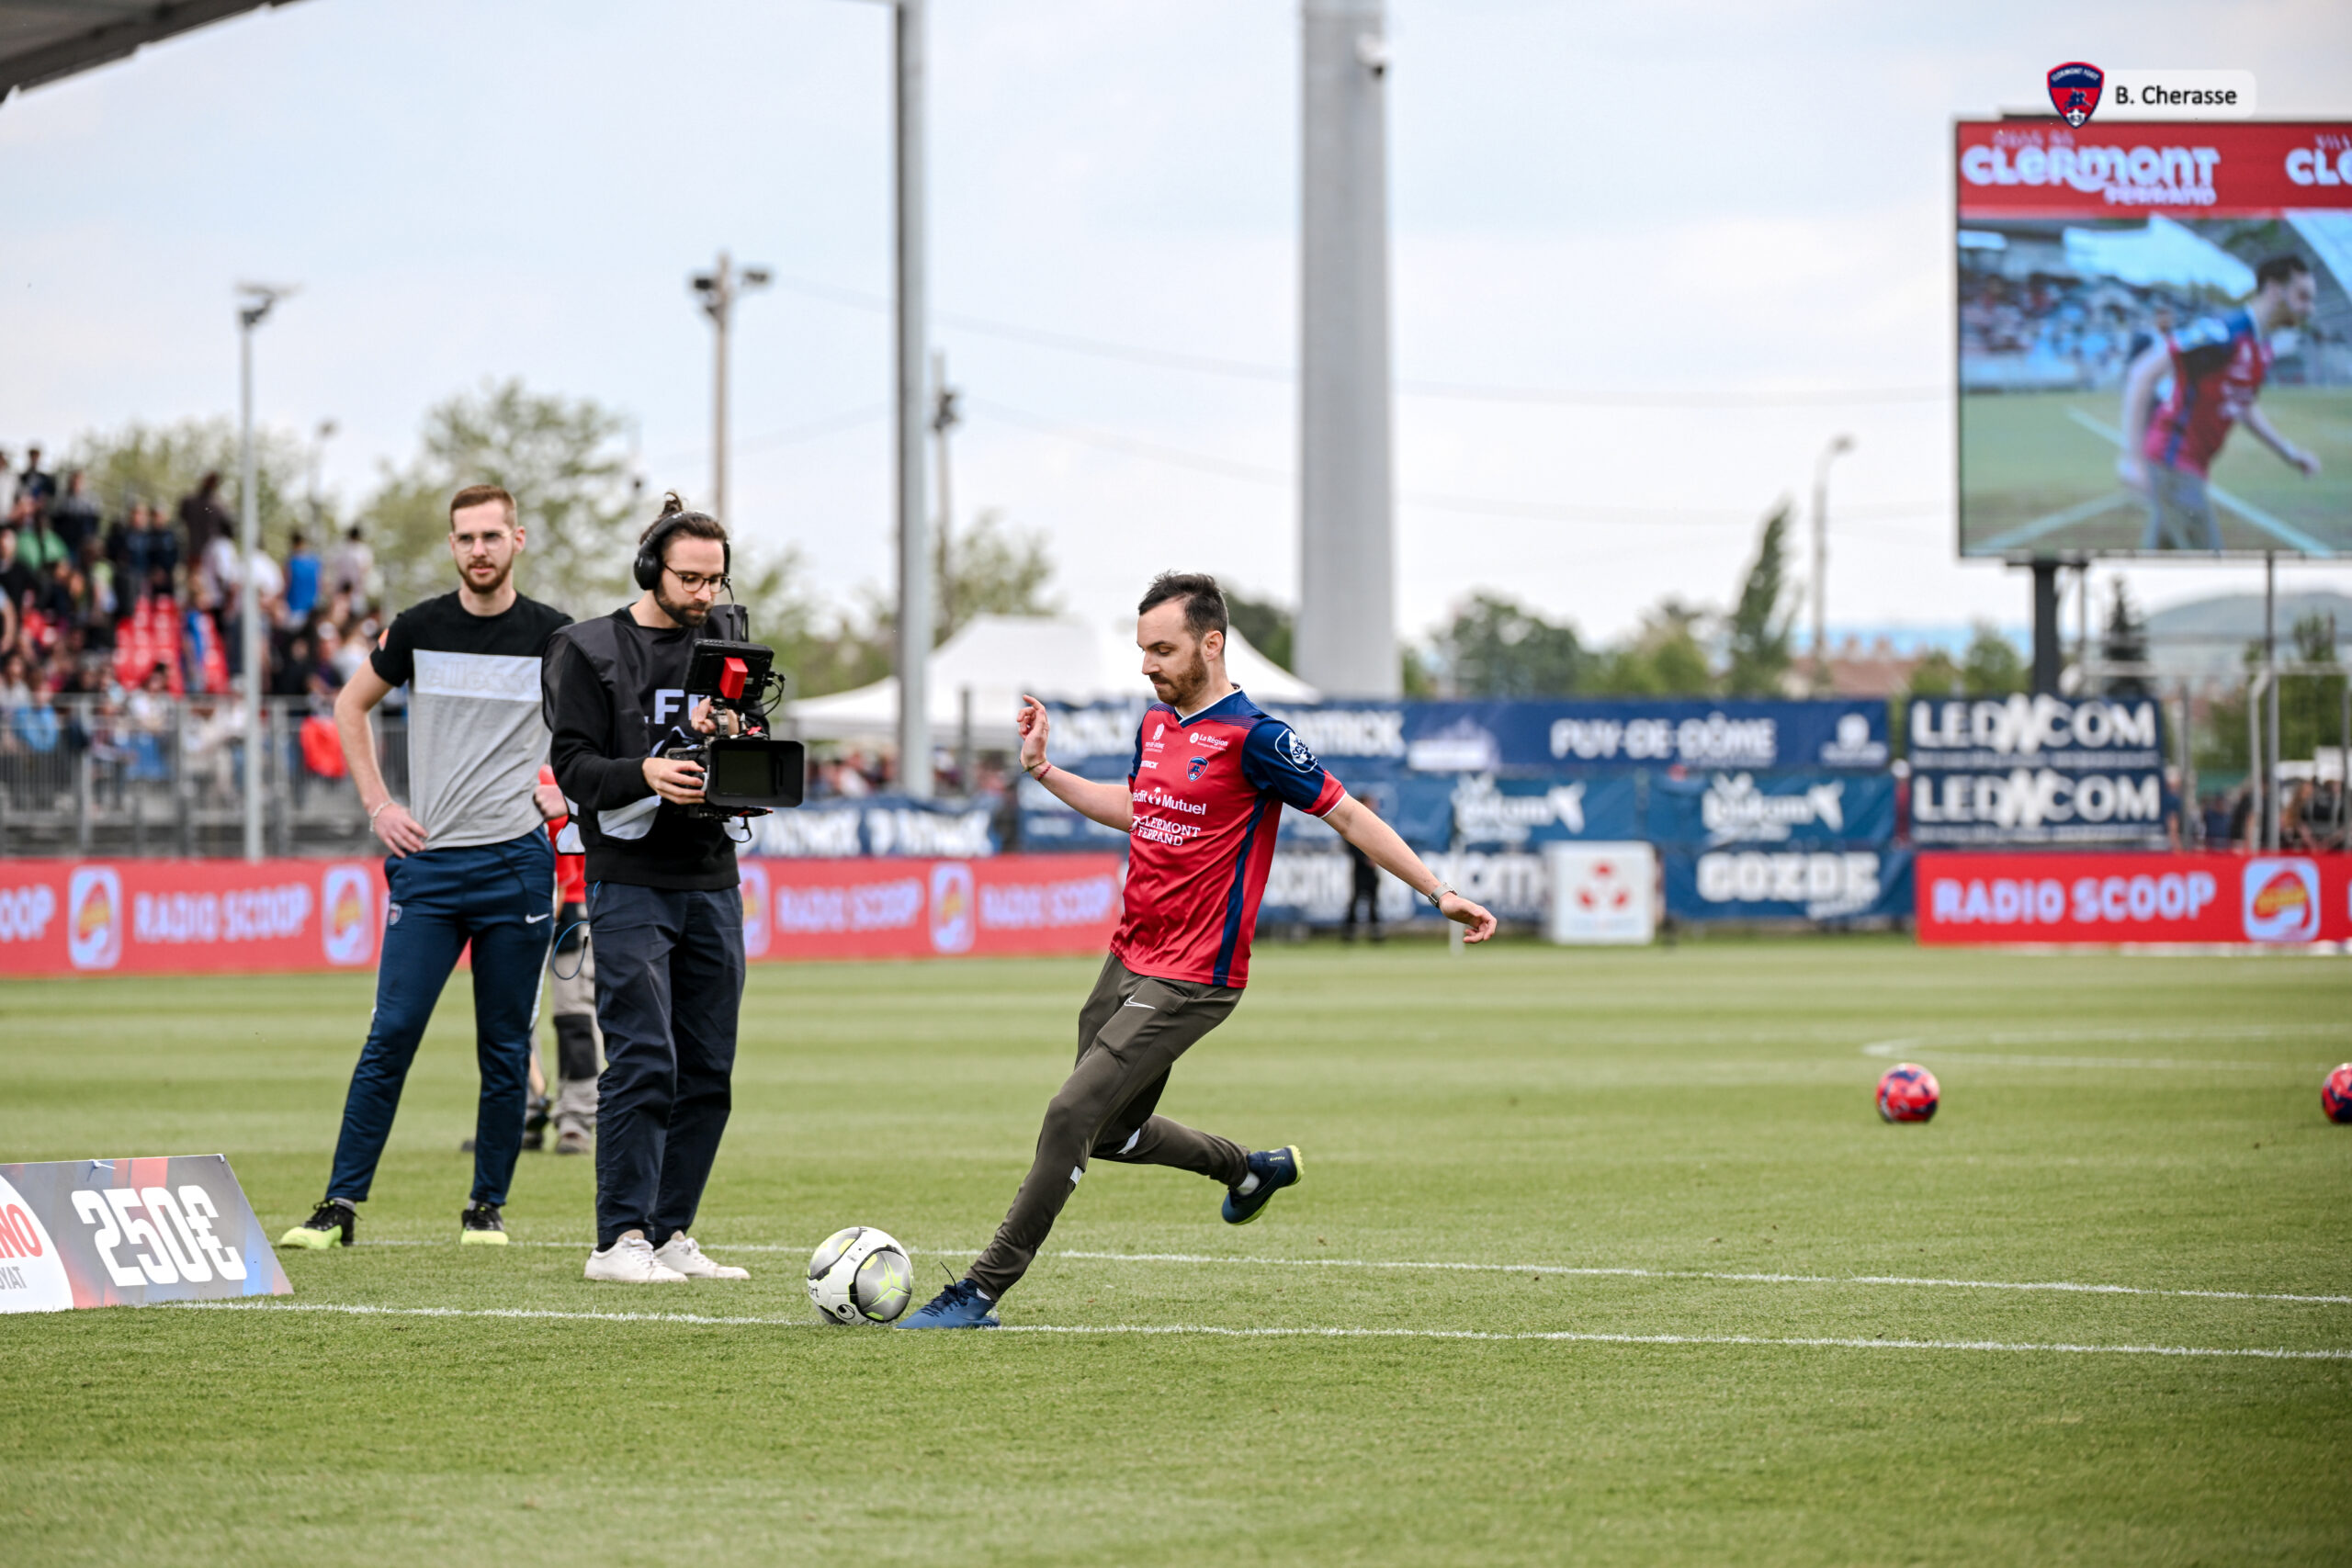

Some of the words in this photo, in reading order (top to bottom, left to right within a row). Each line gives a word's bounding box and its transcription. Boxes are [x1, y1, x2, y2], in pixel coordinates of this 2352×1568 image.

[1199, 733, 1207, 741] La
[1207, 735, 1228, 747] Région
[1162, 795, 1207, 816] Mutuel
[1137, 825, 1183, 847] FERRAND
[1138, 815, 1201, 838] CLERMONT
[1932, 878, 2064, 923] RADIO
[2071, 871, 2217, 922] SCOOP
[0, 1203, 43, 1258] NO
[71, 1185, 247, 1286] 250€
